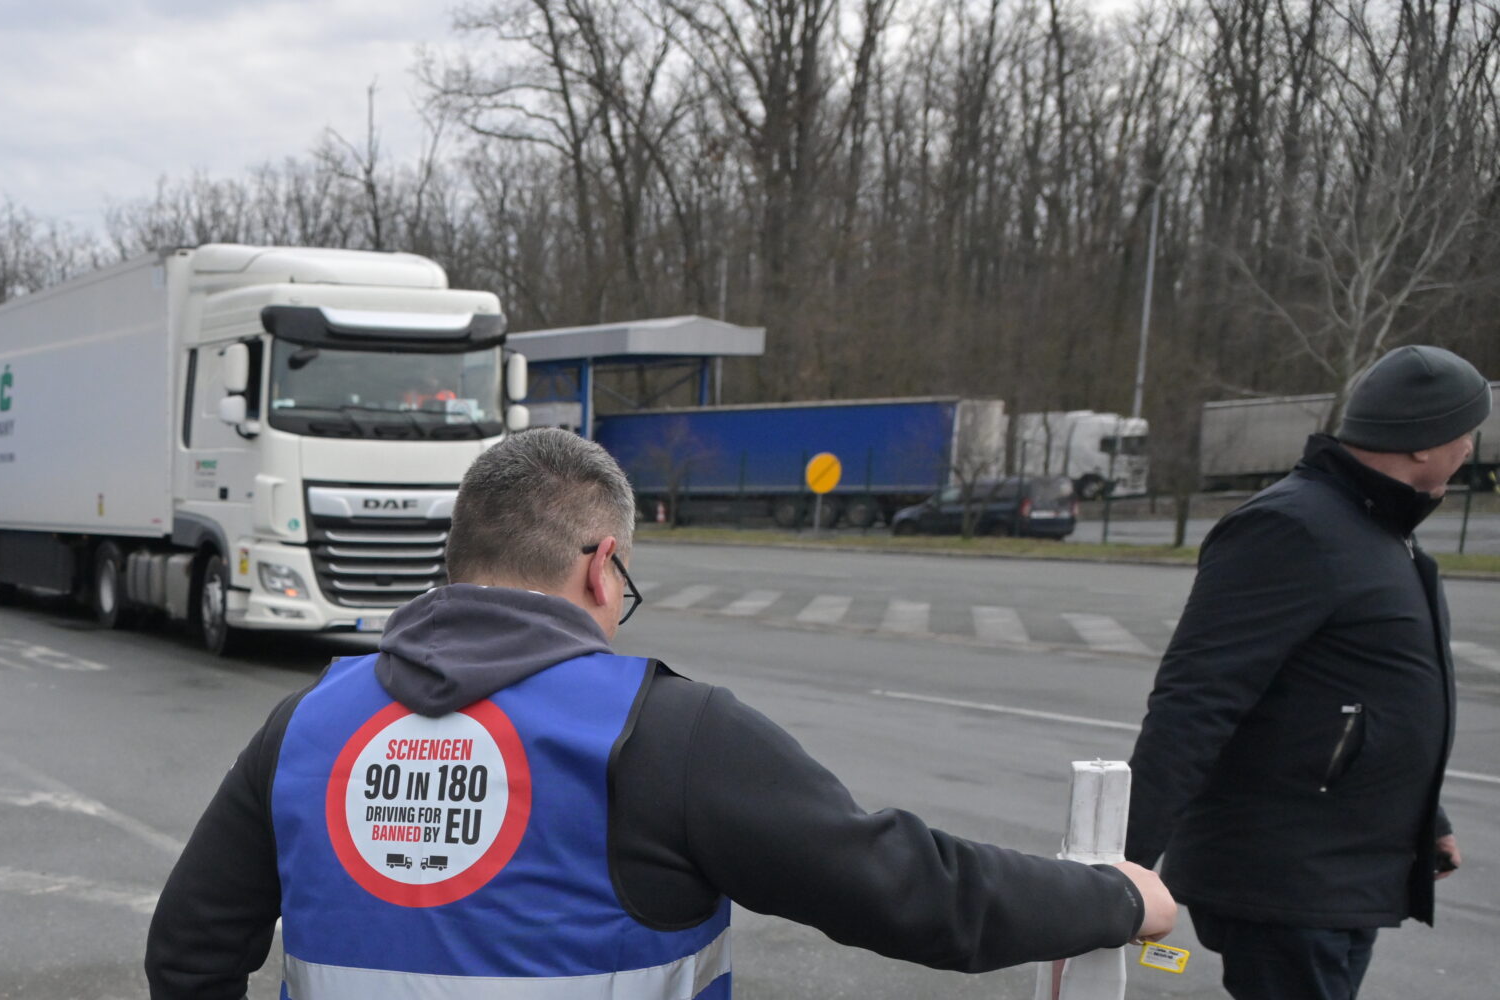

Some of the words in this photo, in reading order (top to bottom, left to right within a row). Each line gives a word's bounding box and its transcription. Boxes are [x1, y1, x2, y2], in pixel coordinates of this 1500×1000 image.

[363, 499, 418, 509] DAF
[386, 739, 473, 760] SCHENGEN
[364, 764, 399, 800] 90
[406, 772, 430, 800] IN
[437, 764, 488, 802] 180
[366, 806, 415, 823] DRIVING
[418, 807, 442, 824] FOR
[444, 808, 482, 845] EU
[371, 825, 421, 843] BANNED
[423, 826, 440, 843] BY
